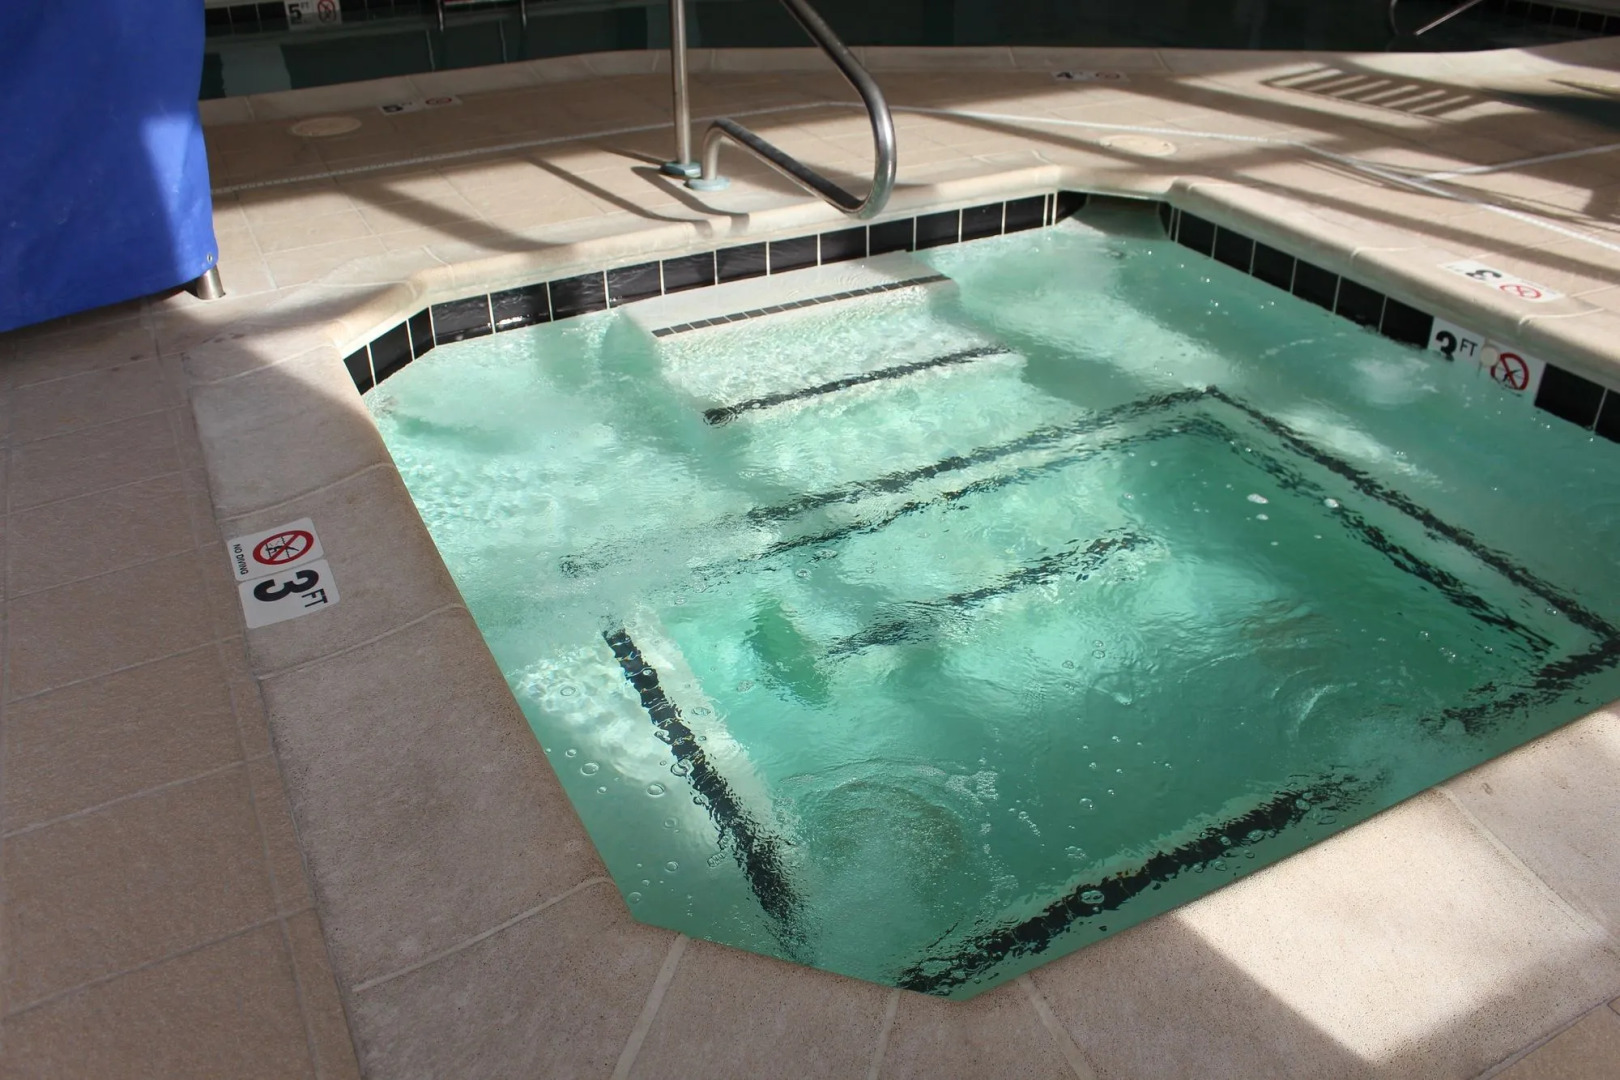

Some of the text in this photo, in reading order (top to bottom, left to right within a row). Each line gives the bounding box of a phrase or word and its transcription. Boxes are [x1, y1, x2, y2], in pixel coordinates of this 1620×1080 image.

[288, 3, 302, 19] 5
[1435, 330, 1478, 361] 3 FT
[233, 543, 249, 575] NO DIVING
[253, 569, 328, 608] 3 FT
